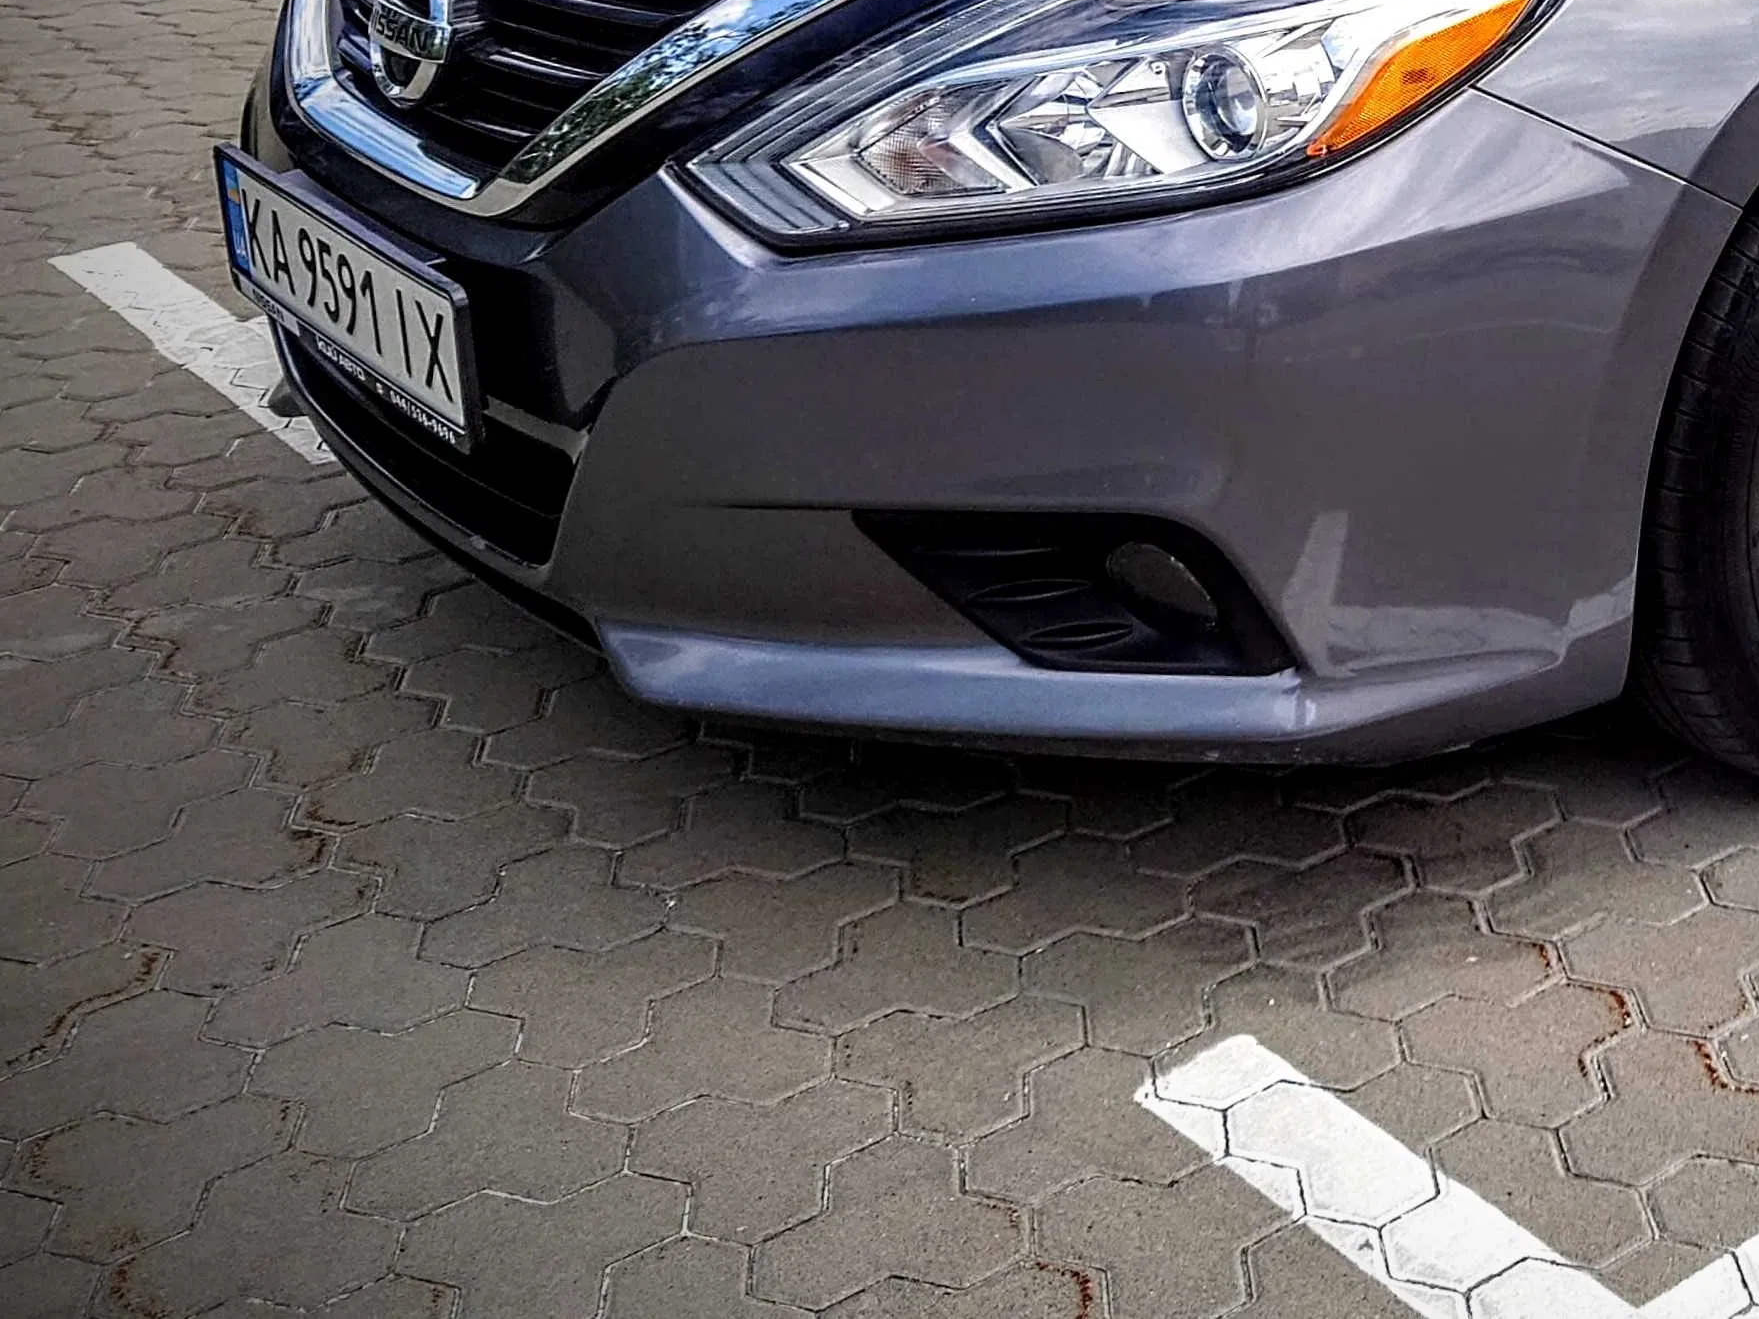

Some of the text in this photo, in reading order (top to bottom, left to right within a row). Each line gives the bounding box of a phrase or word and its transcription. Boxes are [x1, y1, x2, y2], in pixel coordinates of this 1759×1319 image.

[241, 188, 454, 403] KA 9591 IX
